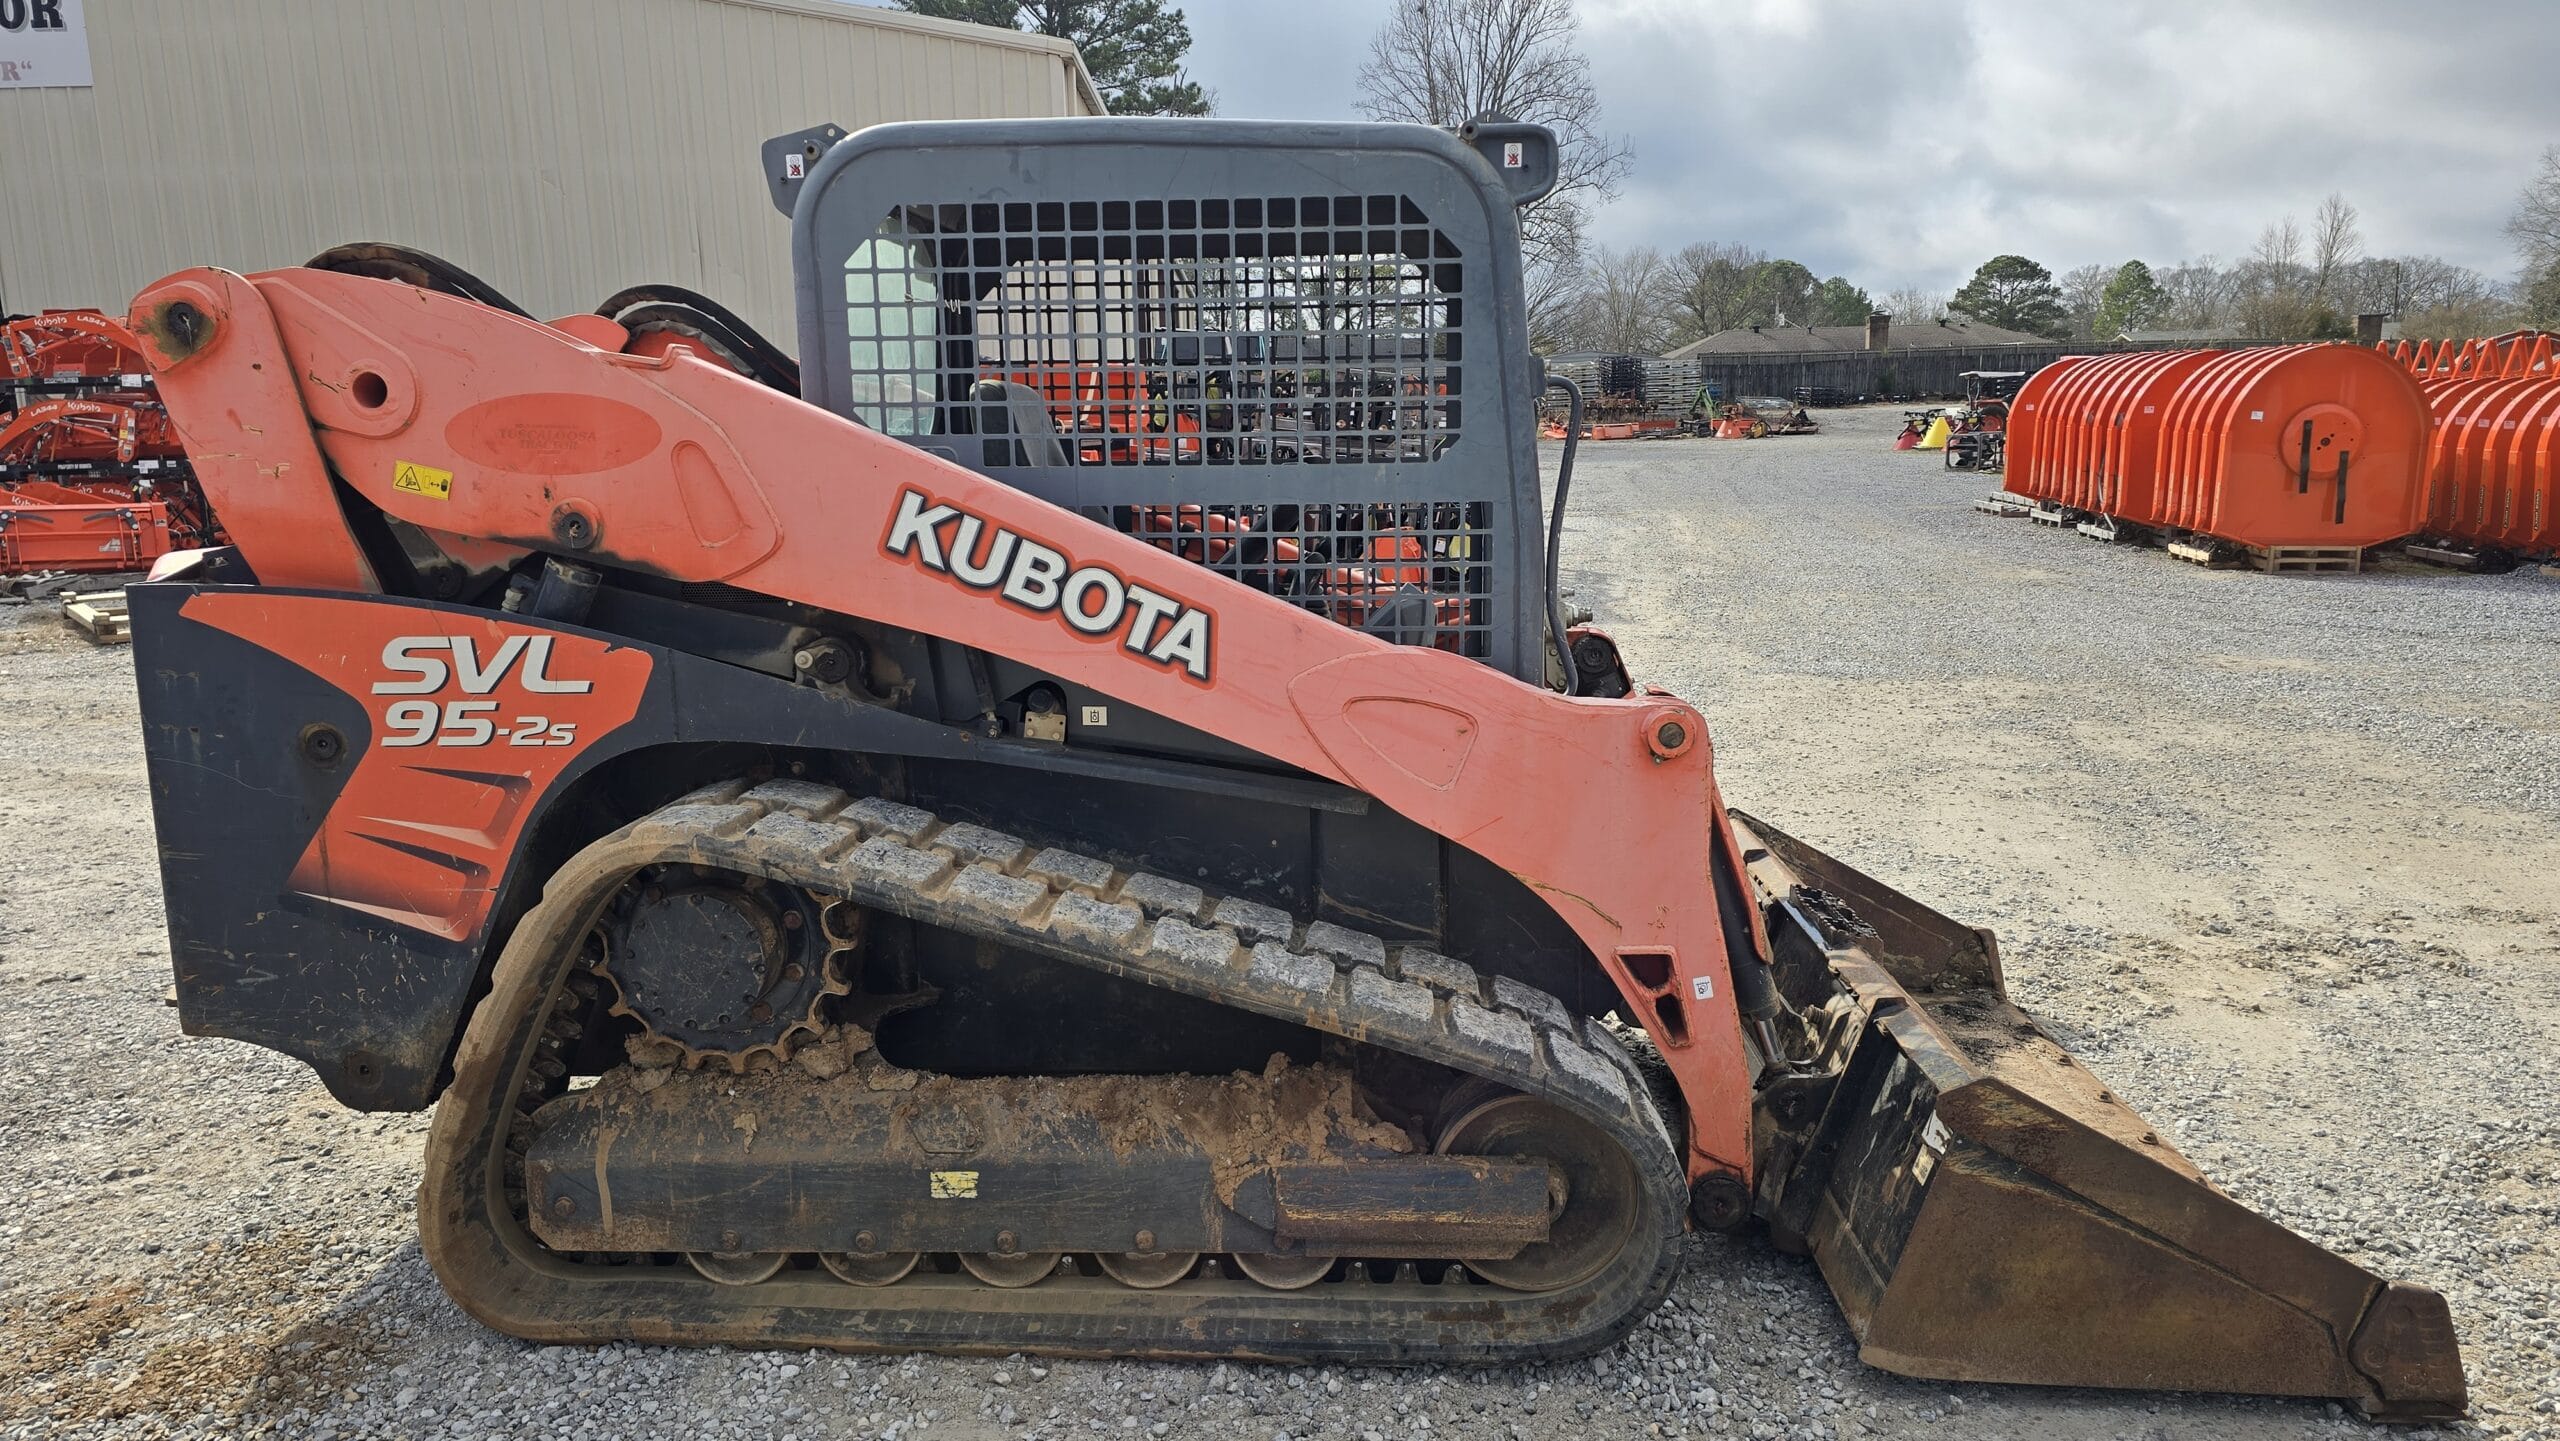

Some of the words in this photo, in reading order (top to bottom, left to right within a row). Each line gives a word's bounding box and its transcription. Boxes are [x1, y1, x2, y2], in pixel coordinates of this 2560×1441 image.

[34, 315, 68, 327] Kubota
[67, 401, 101, 412] Kubota
[886, 489, 1209, 680] KUBOTA
[371, 635, 594, 695] SVL
